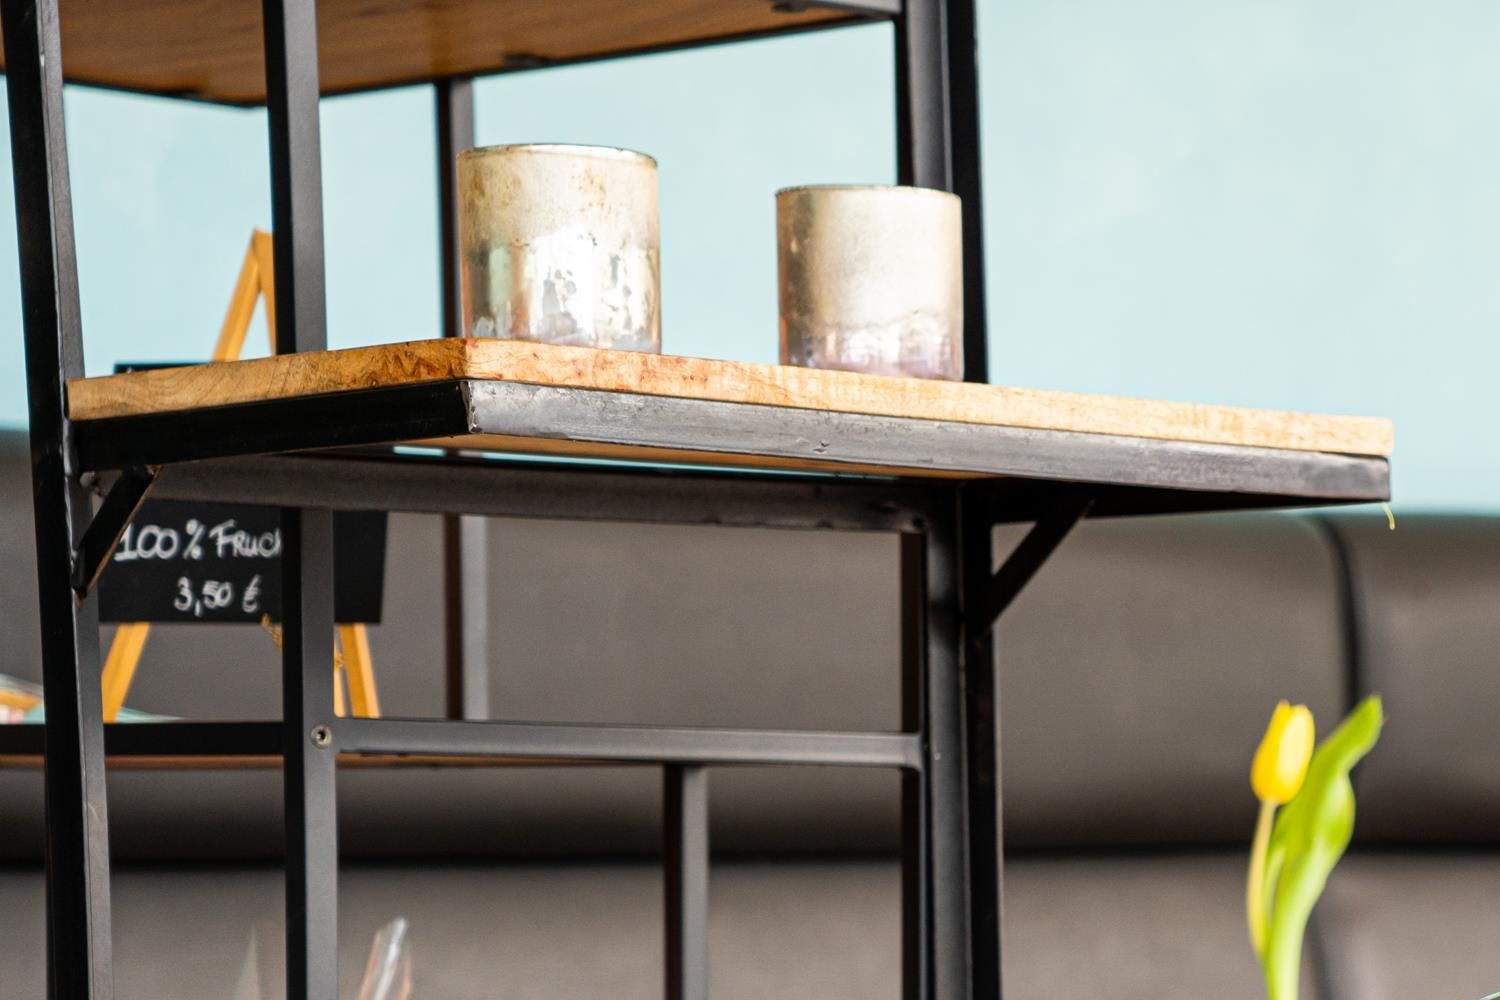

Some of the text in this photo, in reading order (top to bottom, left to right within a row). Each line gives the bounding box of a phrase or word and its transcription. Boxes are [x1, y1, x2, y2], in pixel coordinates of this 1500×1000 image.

[114, 524, 180, 562] 100
[183, 518, 205, 560] %
[173, 574, 262, 617] 3,50 €
